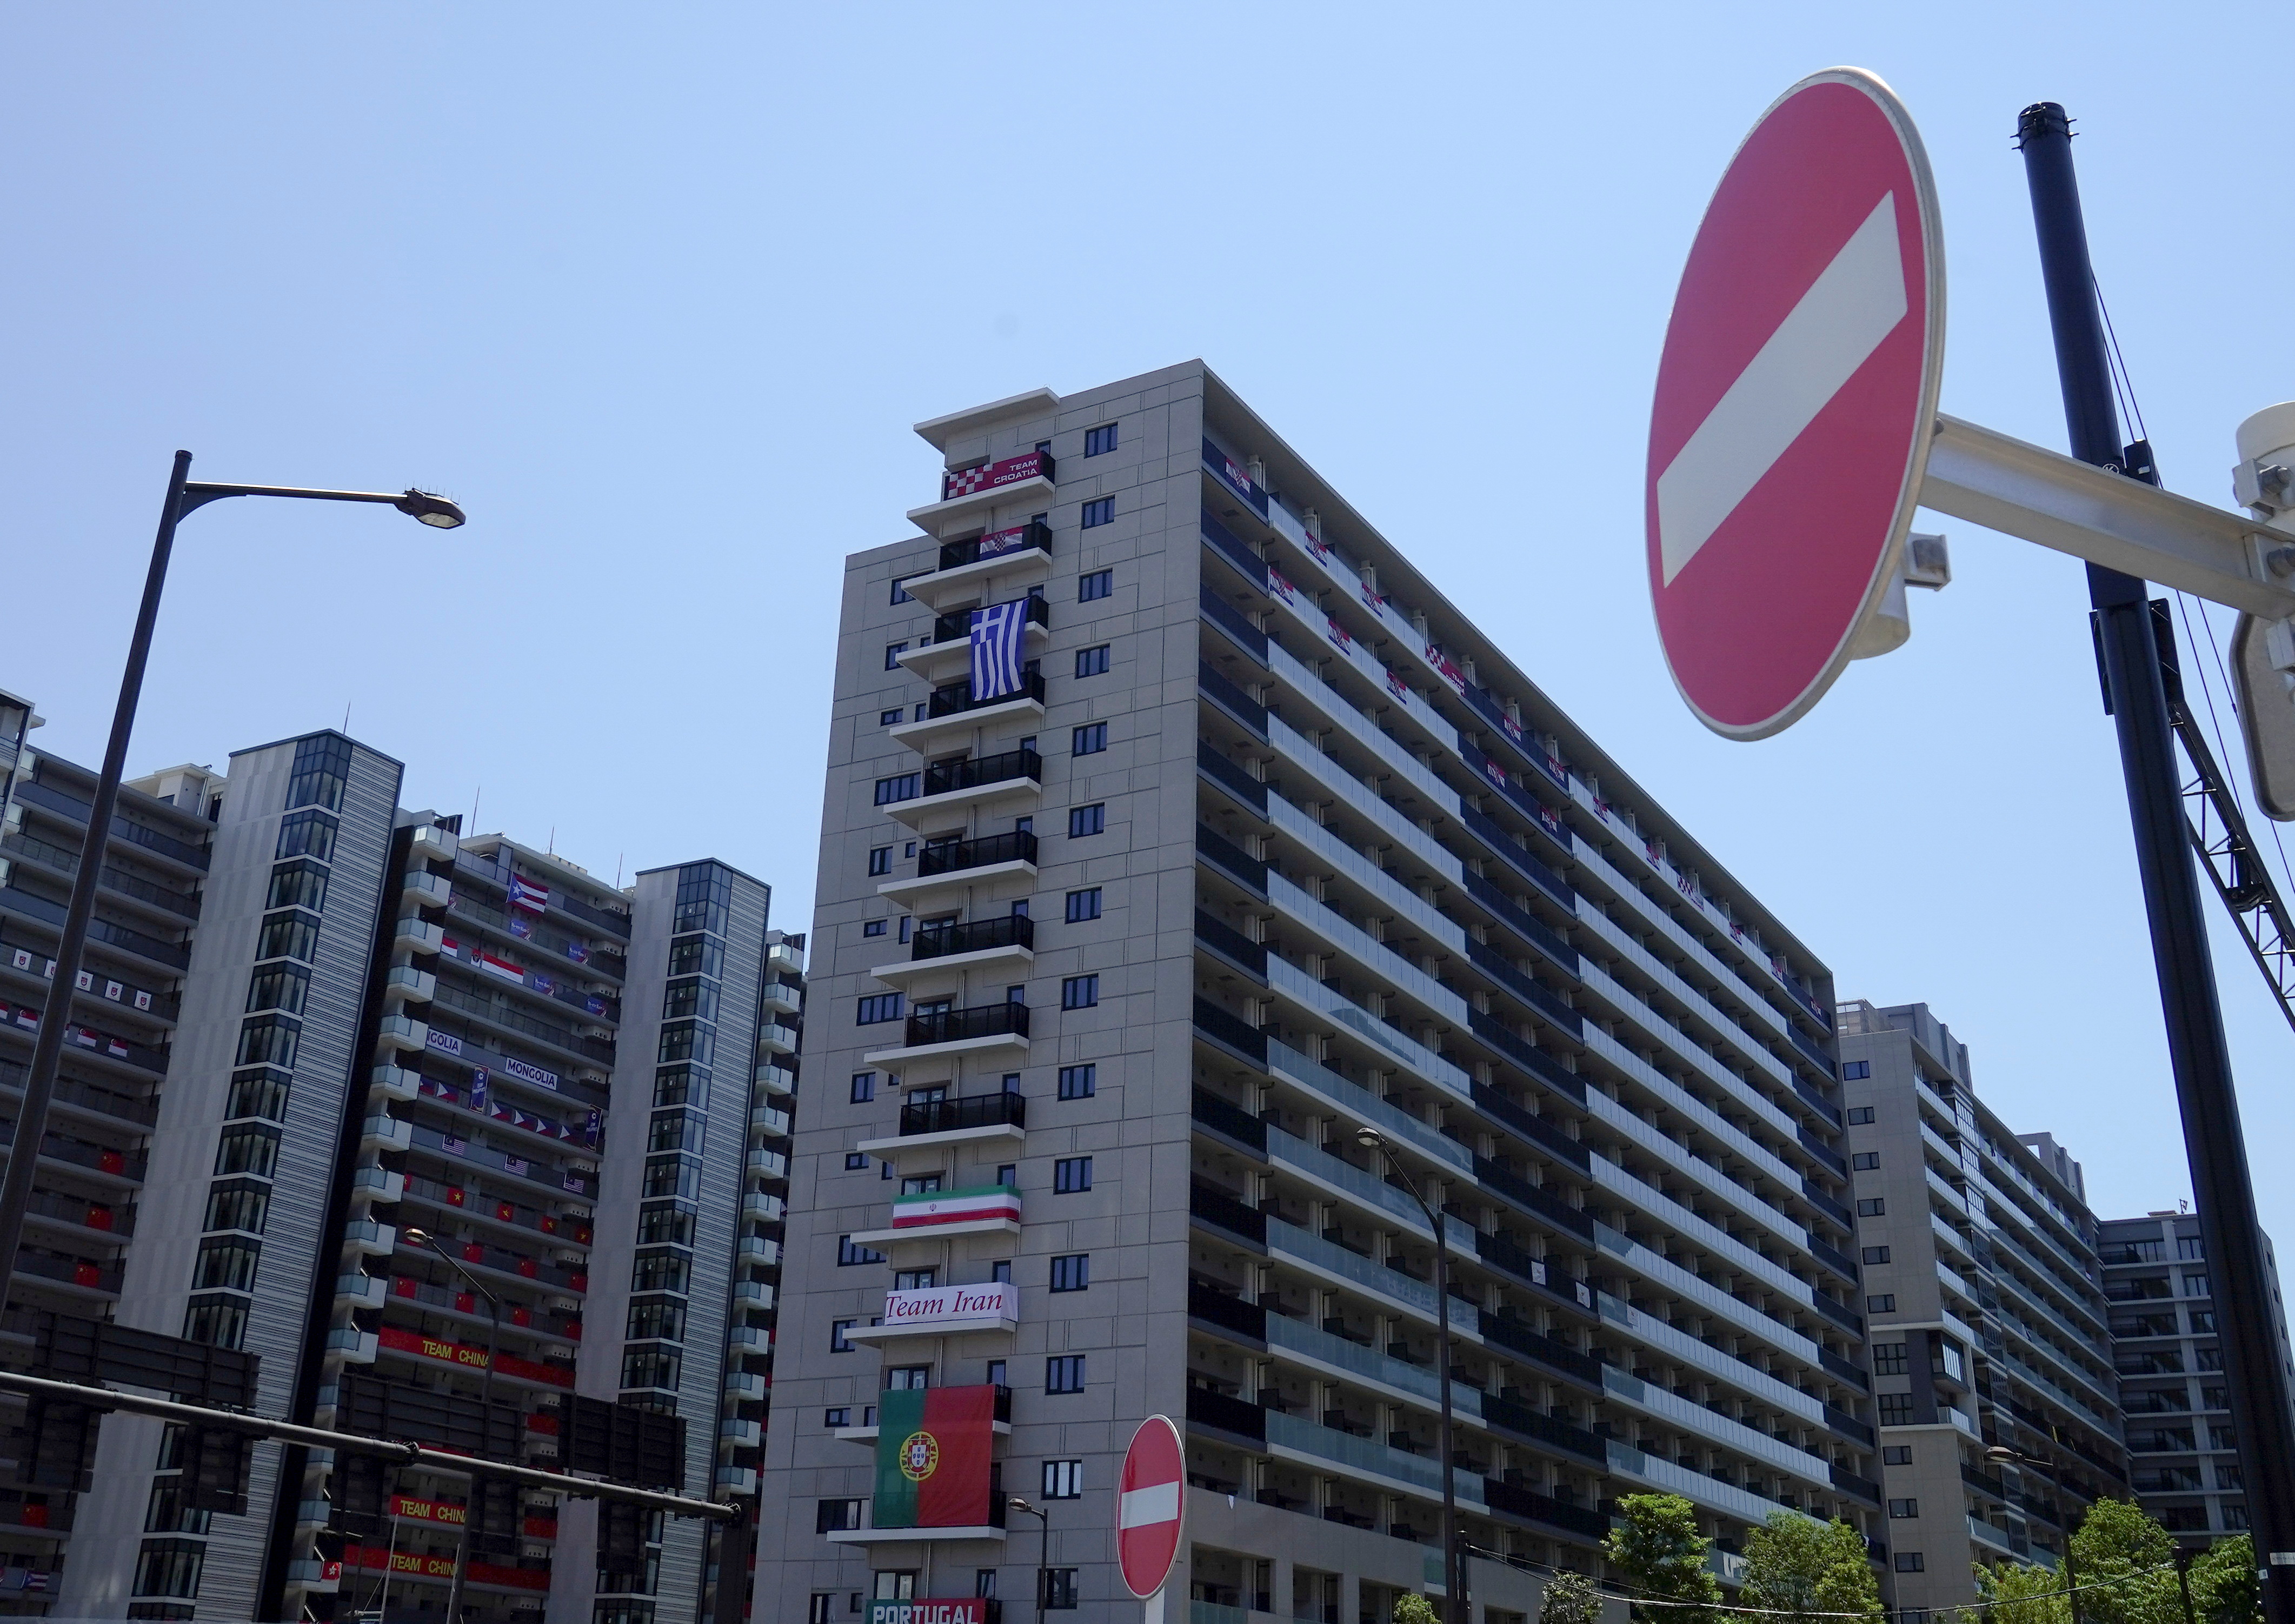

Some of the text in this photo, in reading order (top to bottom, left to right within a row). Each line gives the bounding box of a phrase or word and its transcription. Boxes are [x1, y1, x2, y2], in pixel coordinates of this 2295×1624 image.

[1009, 459, 1038, 471] TEAM
[994, 468, 1038, 484] CROATIA
[507, 1059, 555, 1087] MONGOLIA
[886, 1291, 1002, 1318] Team Iran
[423, 1340, 452, 1359] TEAM
[400, 1500, 431, 1517] TEAM
[391, 1554, 421, 1572] TEAM
[873, 1605, 979, 1624] PORTUGAL
